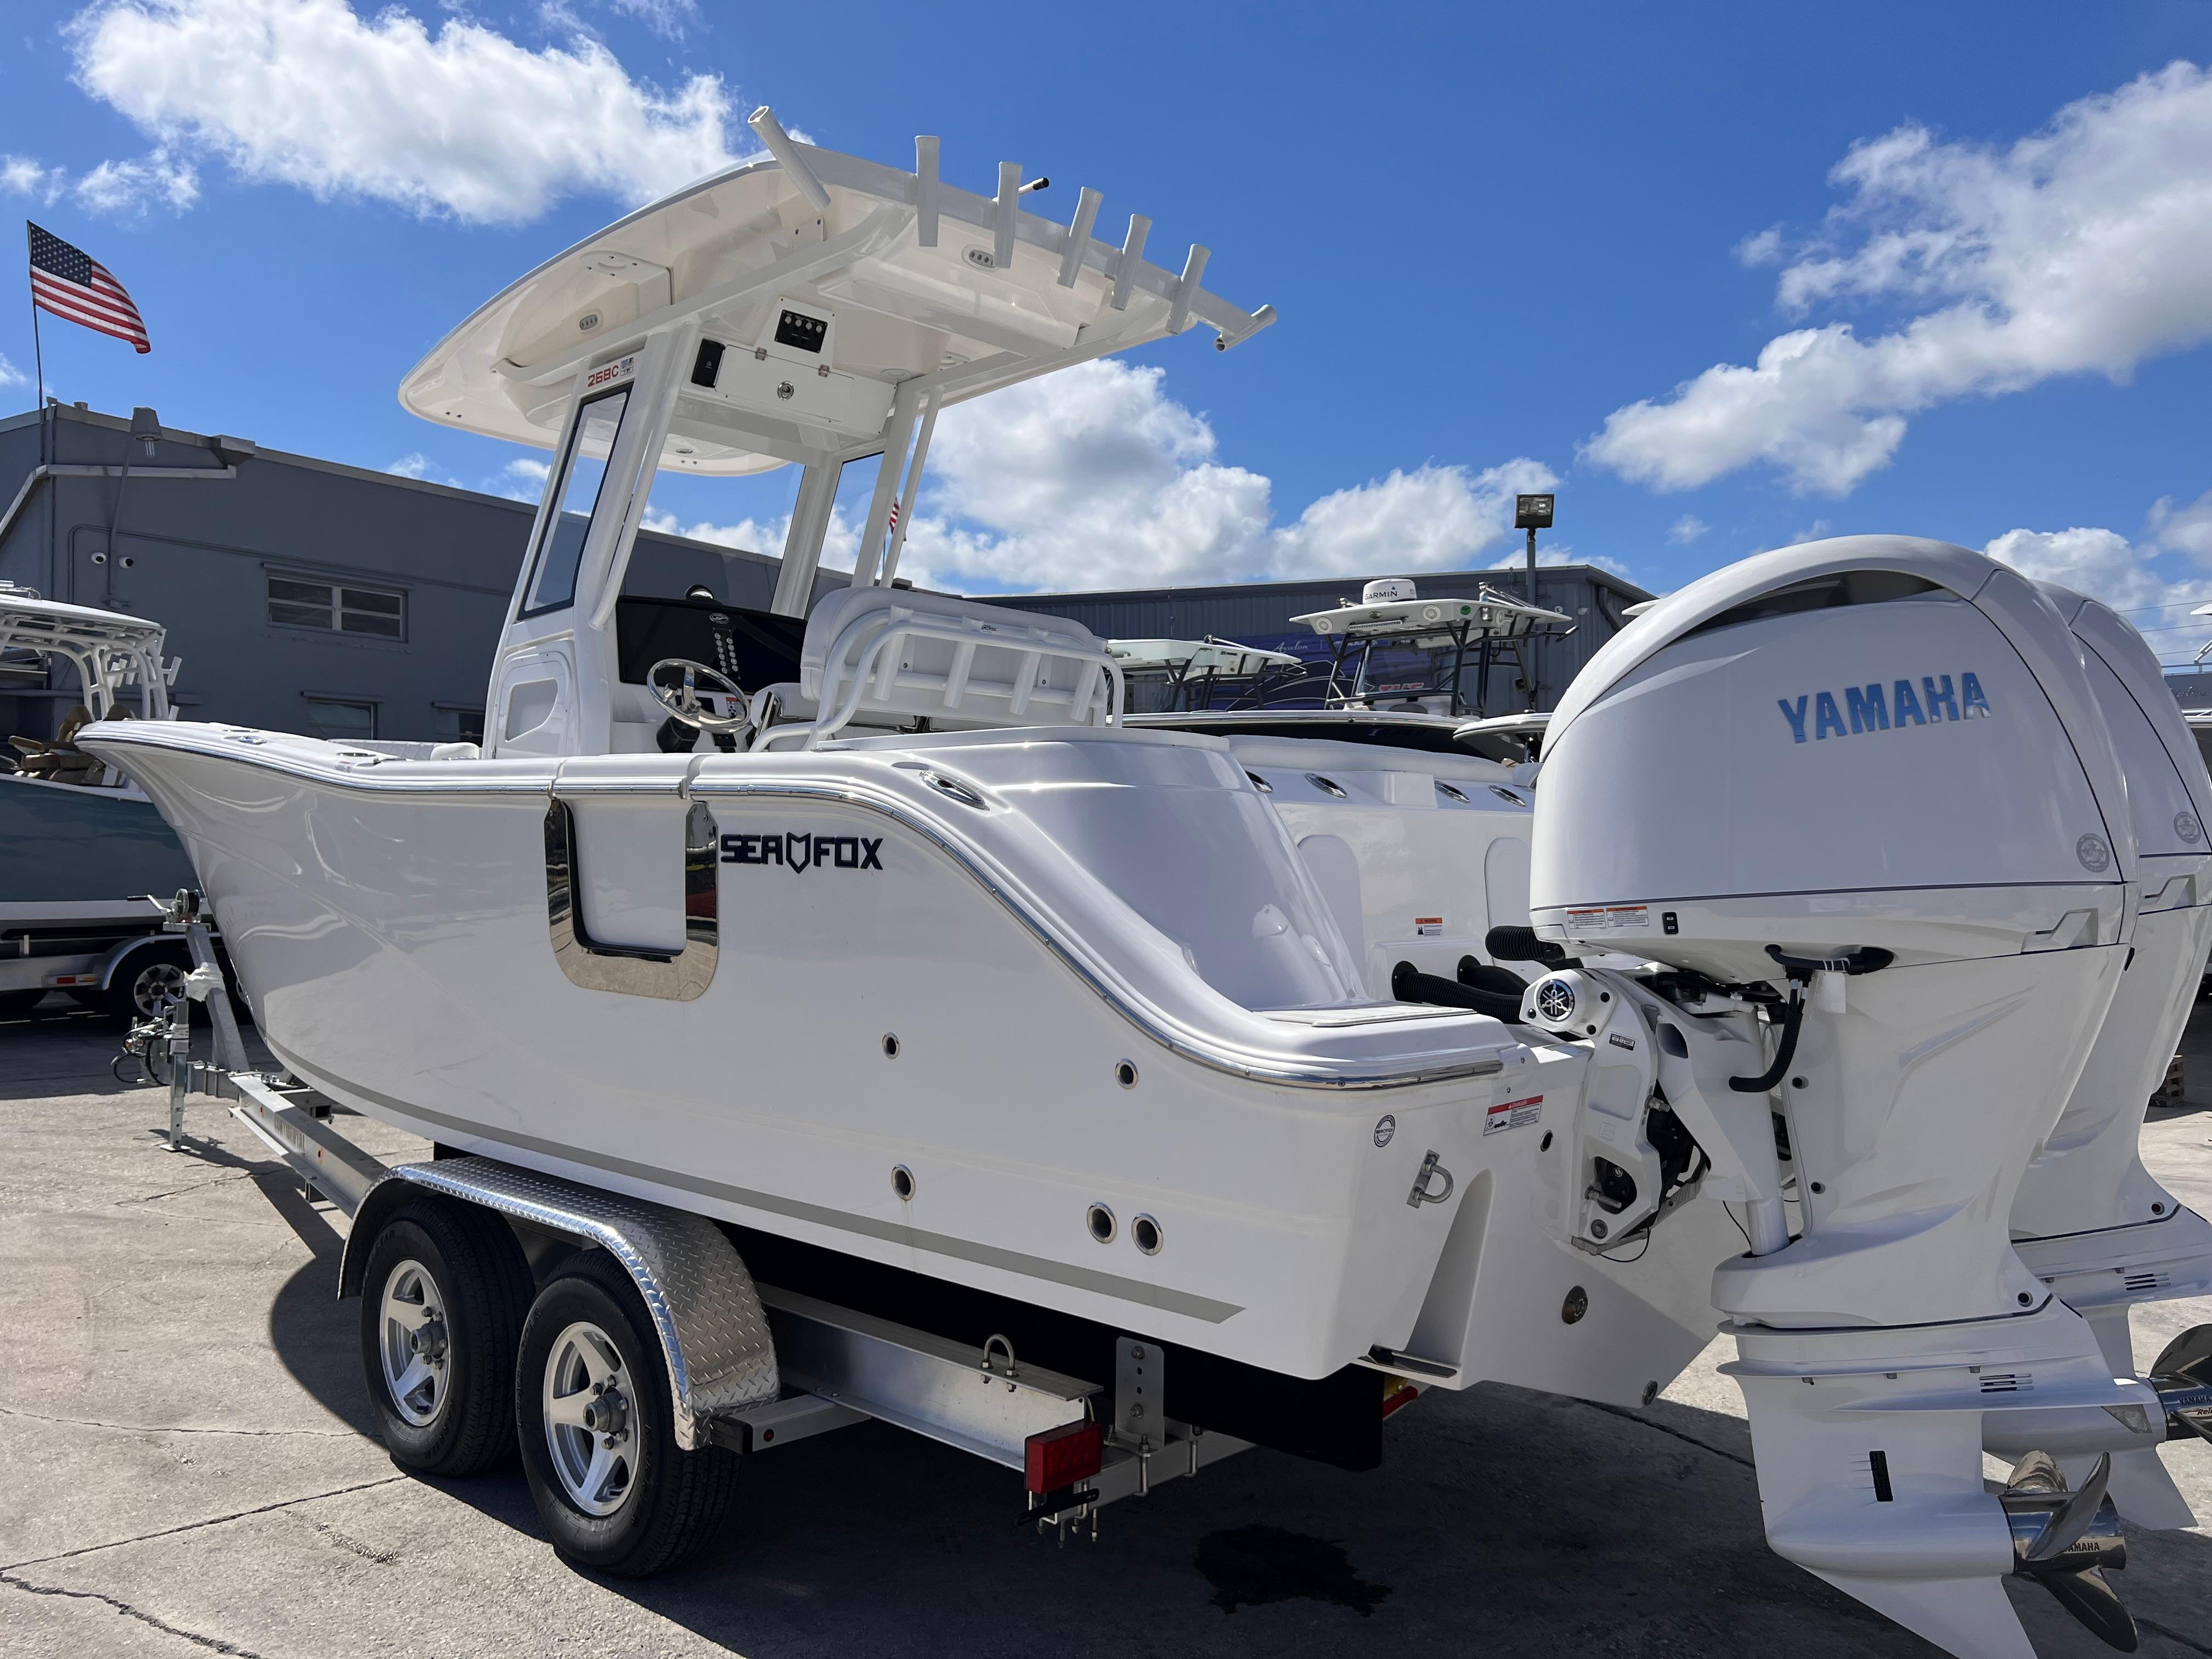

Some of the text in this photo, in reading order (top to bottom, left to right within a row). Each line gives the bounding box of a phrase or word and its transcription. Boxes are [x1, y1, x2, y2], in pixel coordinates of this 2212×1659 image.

[588, 365, 619, 387] 268C
[1364, 590, 1397, 600] GARMIN
[1272, 640, 1308, 654] Avalon
[1778, 672, 1992, 744] YAMAHA
[720, 833, 883, 870] SEA FOX
[1511, 1099, 1528, 1108] DANGER
[2177, 1395, 2212, 1405] YAMAHA
[2067, 1542, 2100, 1552] AMAHA
